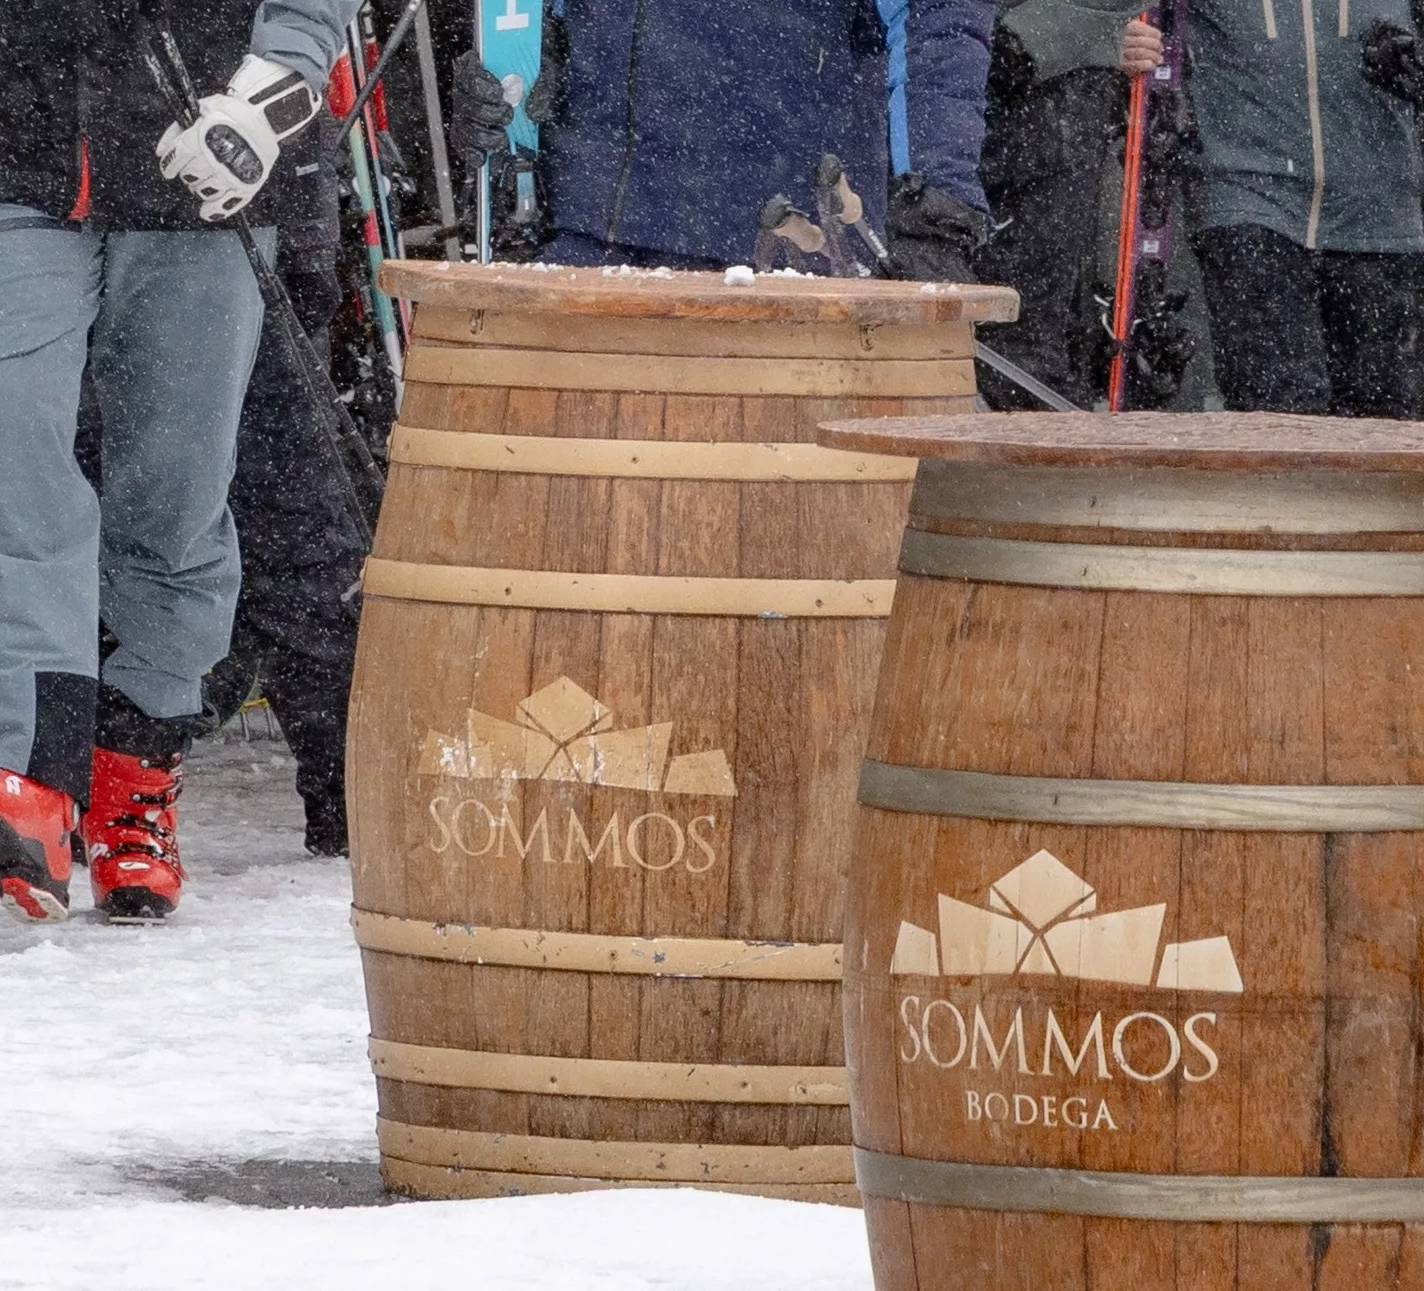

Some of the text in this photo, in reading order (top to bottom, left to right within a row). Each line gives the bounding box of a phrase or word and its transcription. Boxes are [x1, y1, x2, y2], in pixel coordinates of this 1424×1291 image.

[427, 794, 717, 874] SOMMOS
[899, 994, 1220, 1083] SOMMOS
[966, 1090, 1119, 1131] BODEGA
